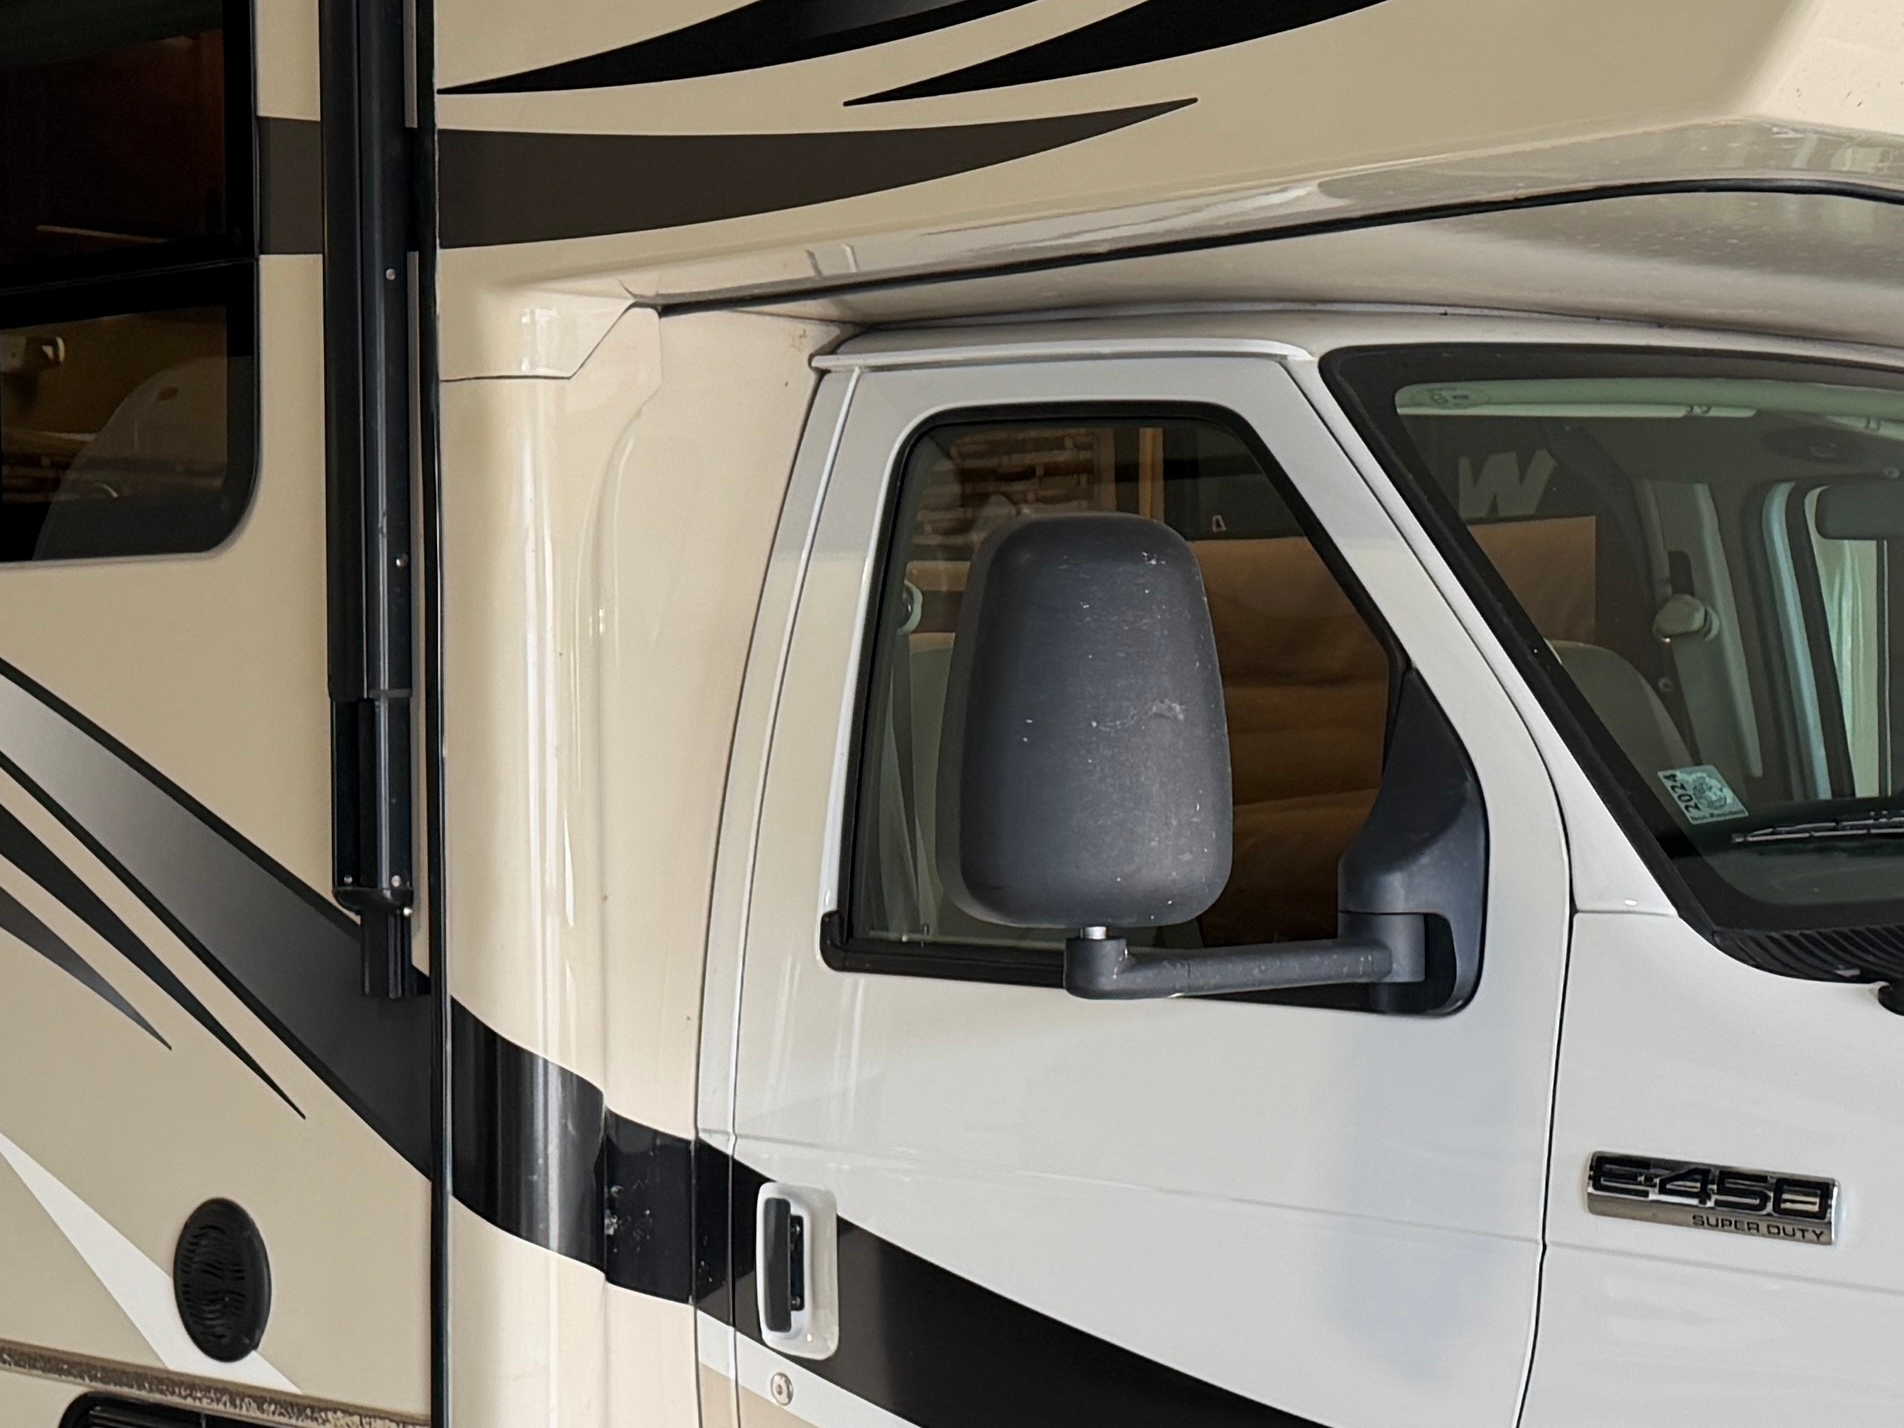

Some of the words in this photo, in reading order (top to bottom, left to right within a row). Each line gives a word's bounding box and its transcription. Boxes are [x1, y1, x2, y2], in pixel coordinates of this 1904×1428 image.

[1662, 772, 1703, 813] 2024
[1592, 1155, 1834, 1221] E-450
[1691, 1213, 1761, 1234] SUPER
[1766, 1223, 1825, 1243] DUTY
